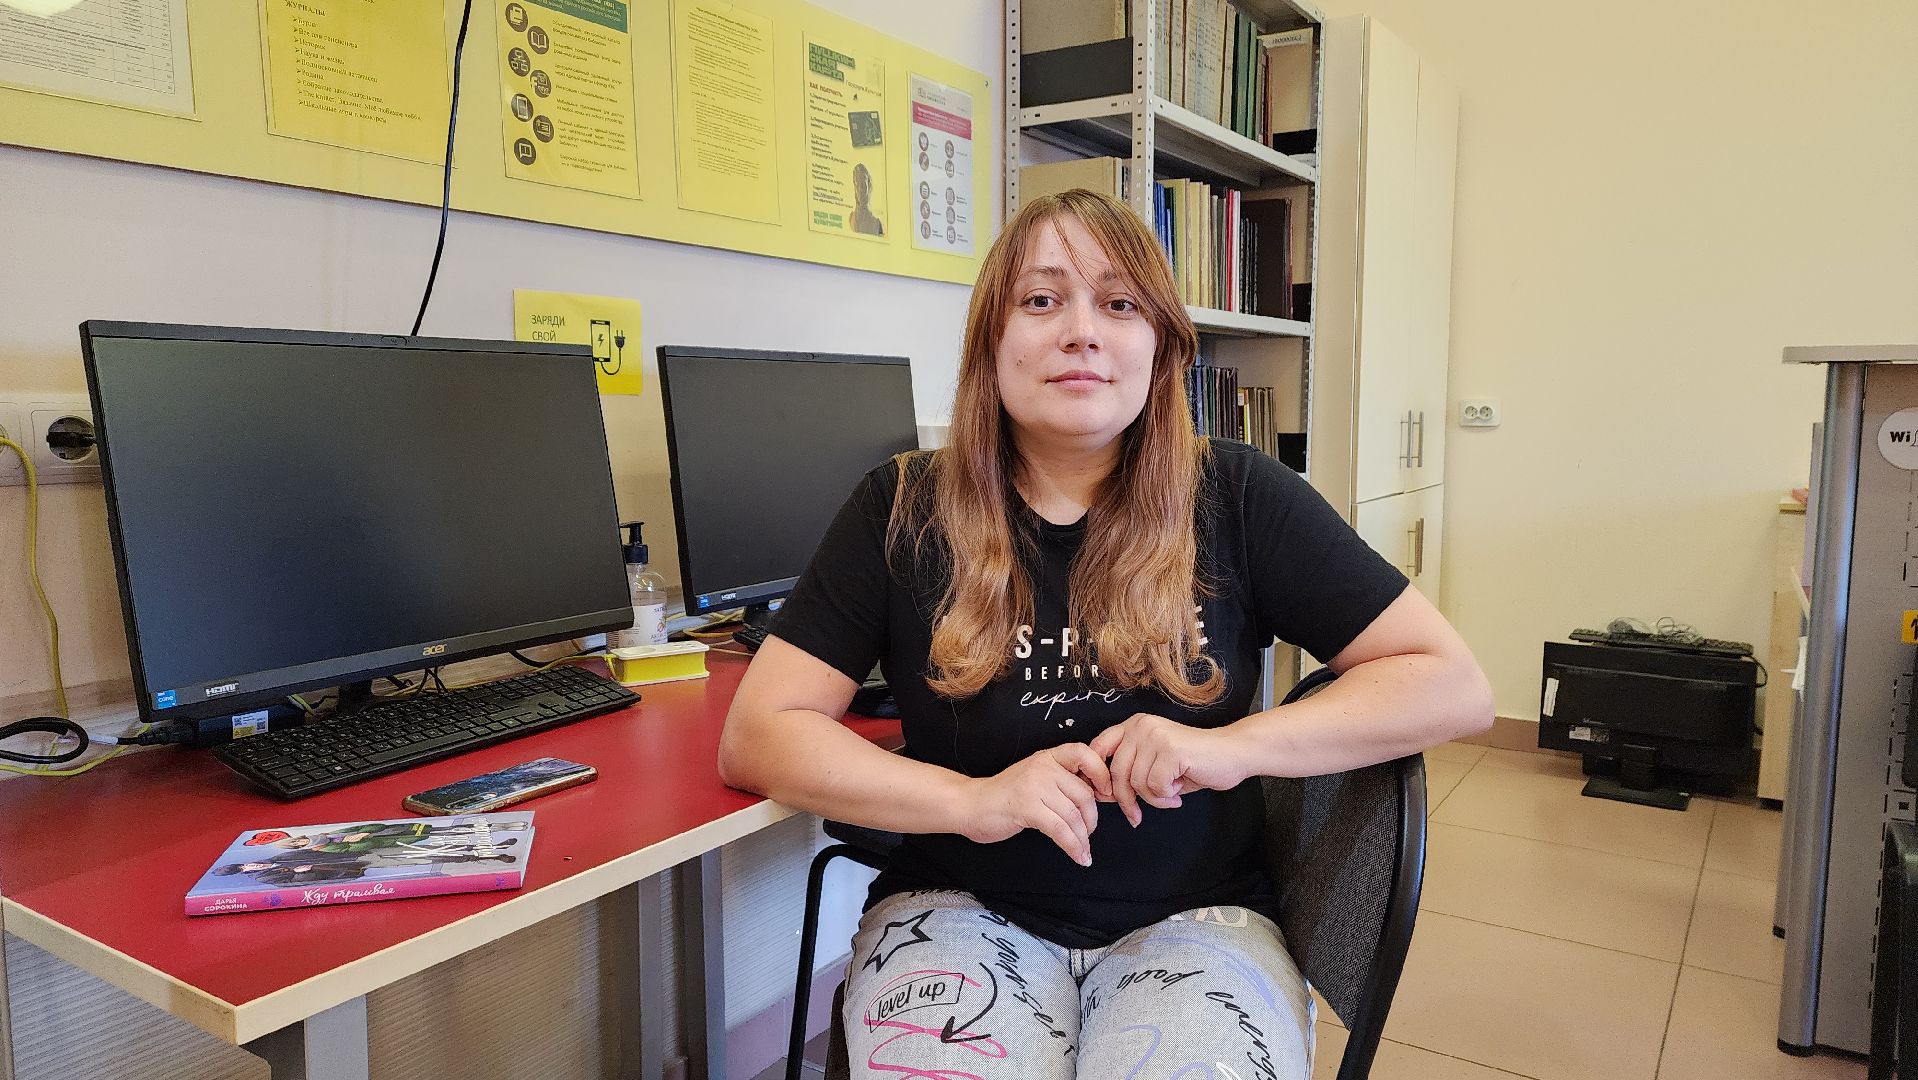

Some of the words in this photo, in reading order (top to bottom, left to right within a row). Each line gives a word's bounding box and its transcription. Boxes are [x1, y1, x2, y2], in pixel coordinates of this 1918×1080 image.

[531, 314, 565, 327] ЗАРЯДИ
[532, 330, 557, 342] СВОЙ
[422, 643, 447, 656] acer
[1020, 688, 1123, 721] expire
[301, 887, 329, 905] Жду
[333, 883, 395, 903] трамвая
[204, 903, 247, 912] СОРОКИНА
[215, 897, 237, 906] ДАРЬЯ
[878, 984, 912, 1021] level
[918, 981, 946, 1002] up
